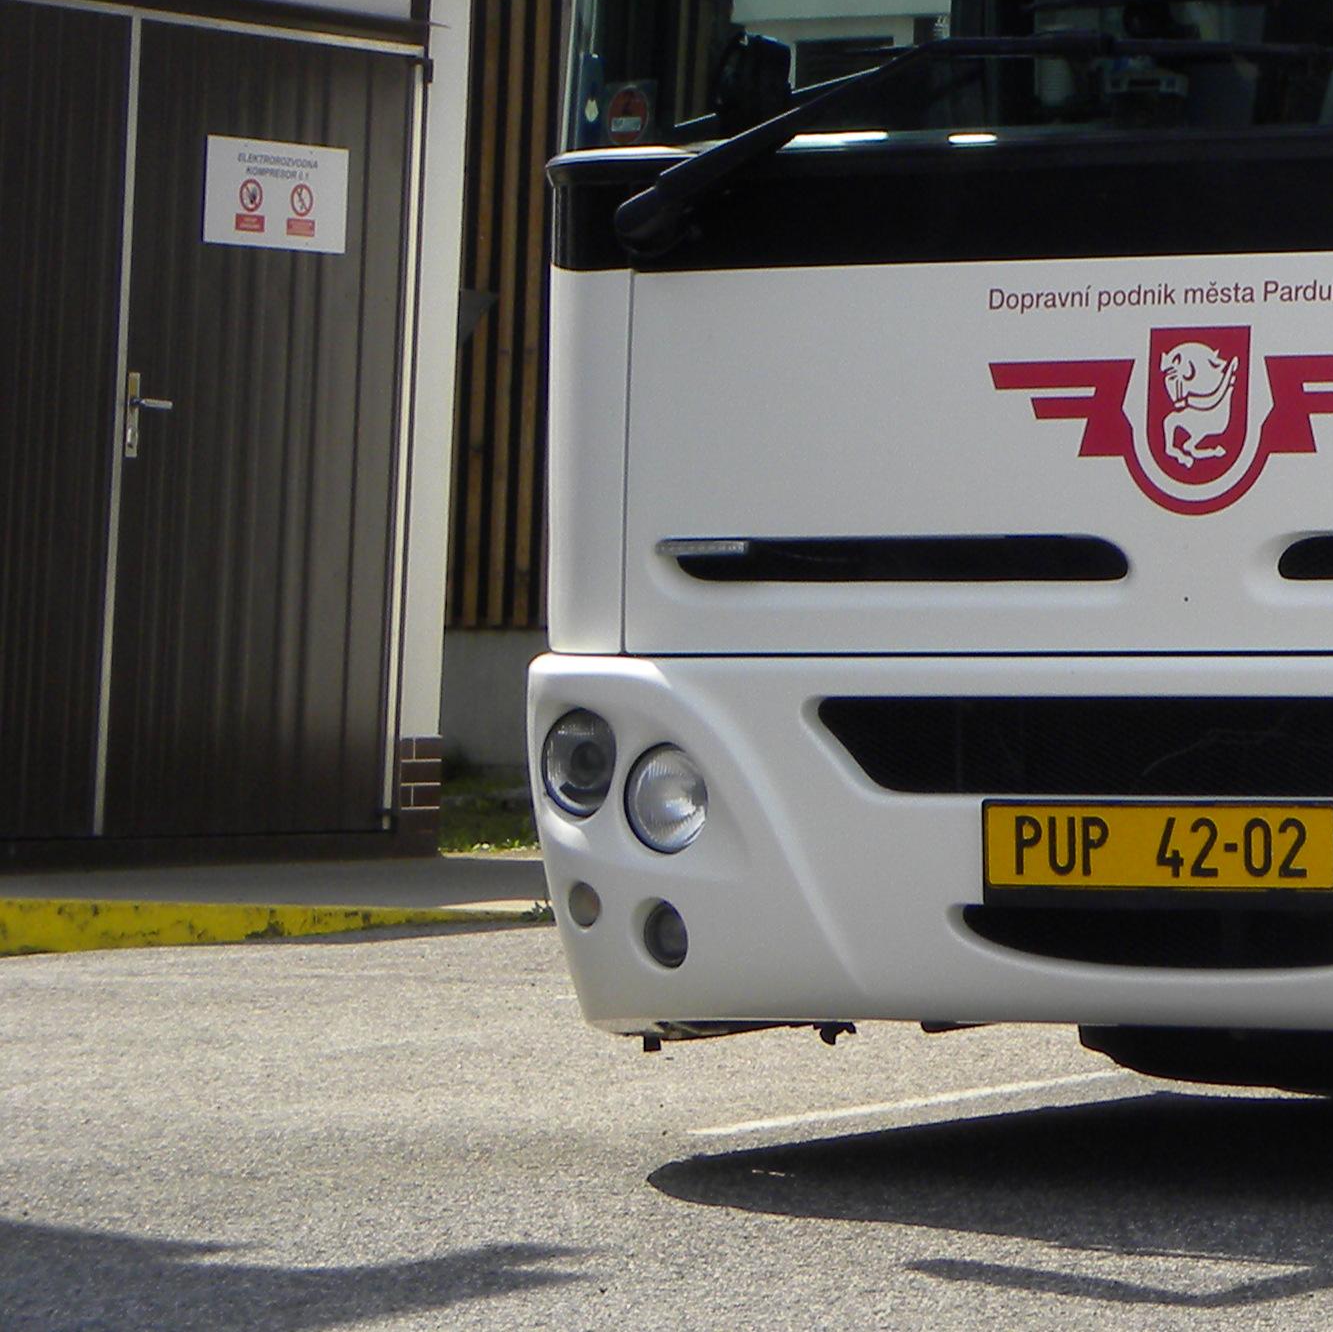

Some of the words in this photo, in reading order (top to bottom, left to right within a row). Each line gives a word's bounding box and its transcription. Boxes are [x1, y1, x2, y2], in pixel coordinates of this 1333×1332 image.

[988, 285, 1091, 313] Dopravní
[1098, 282, 1176, 312] podnik
[1183, 281, 1255, 305] města
[1013, 815, 1110, 877] PUP
[1155, 817, 1308, 878] 42-02
